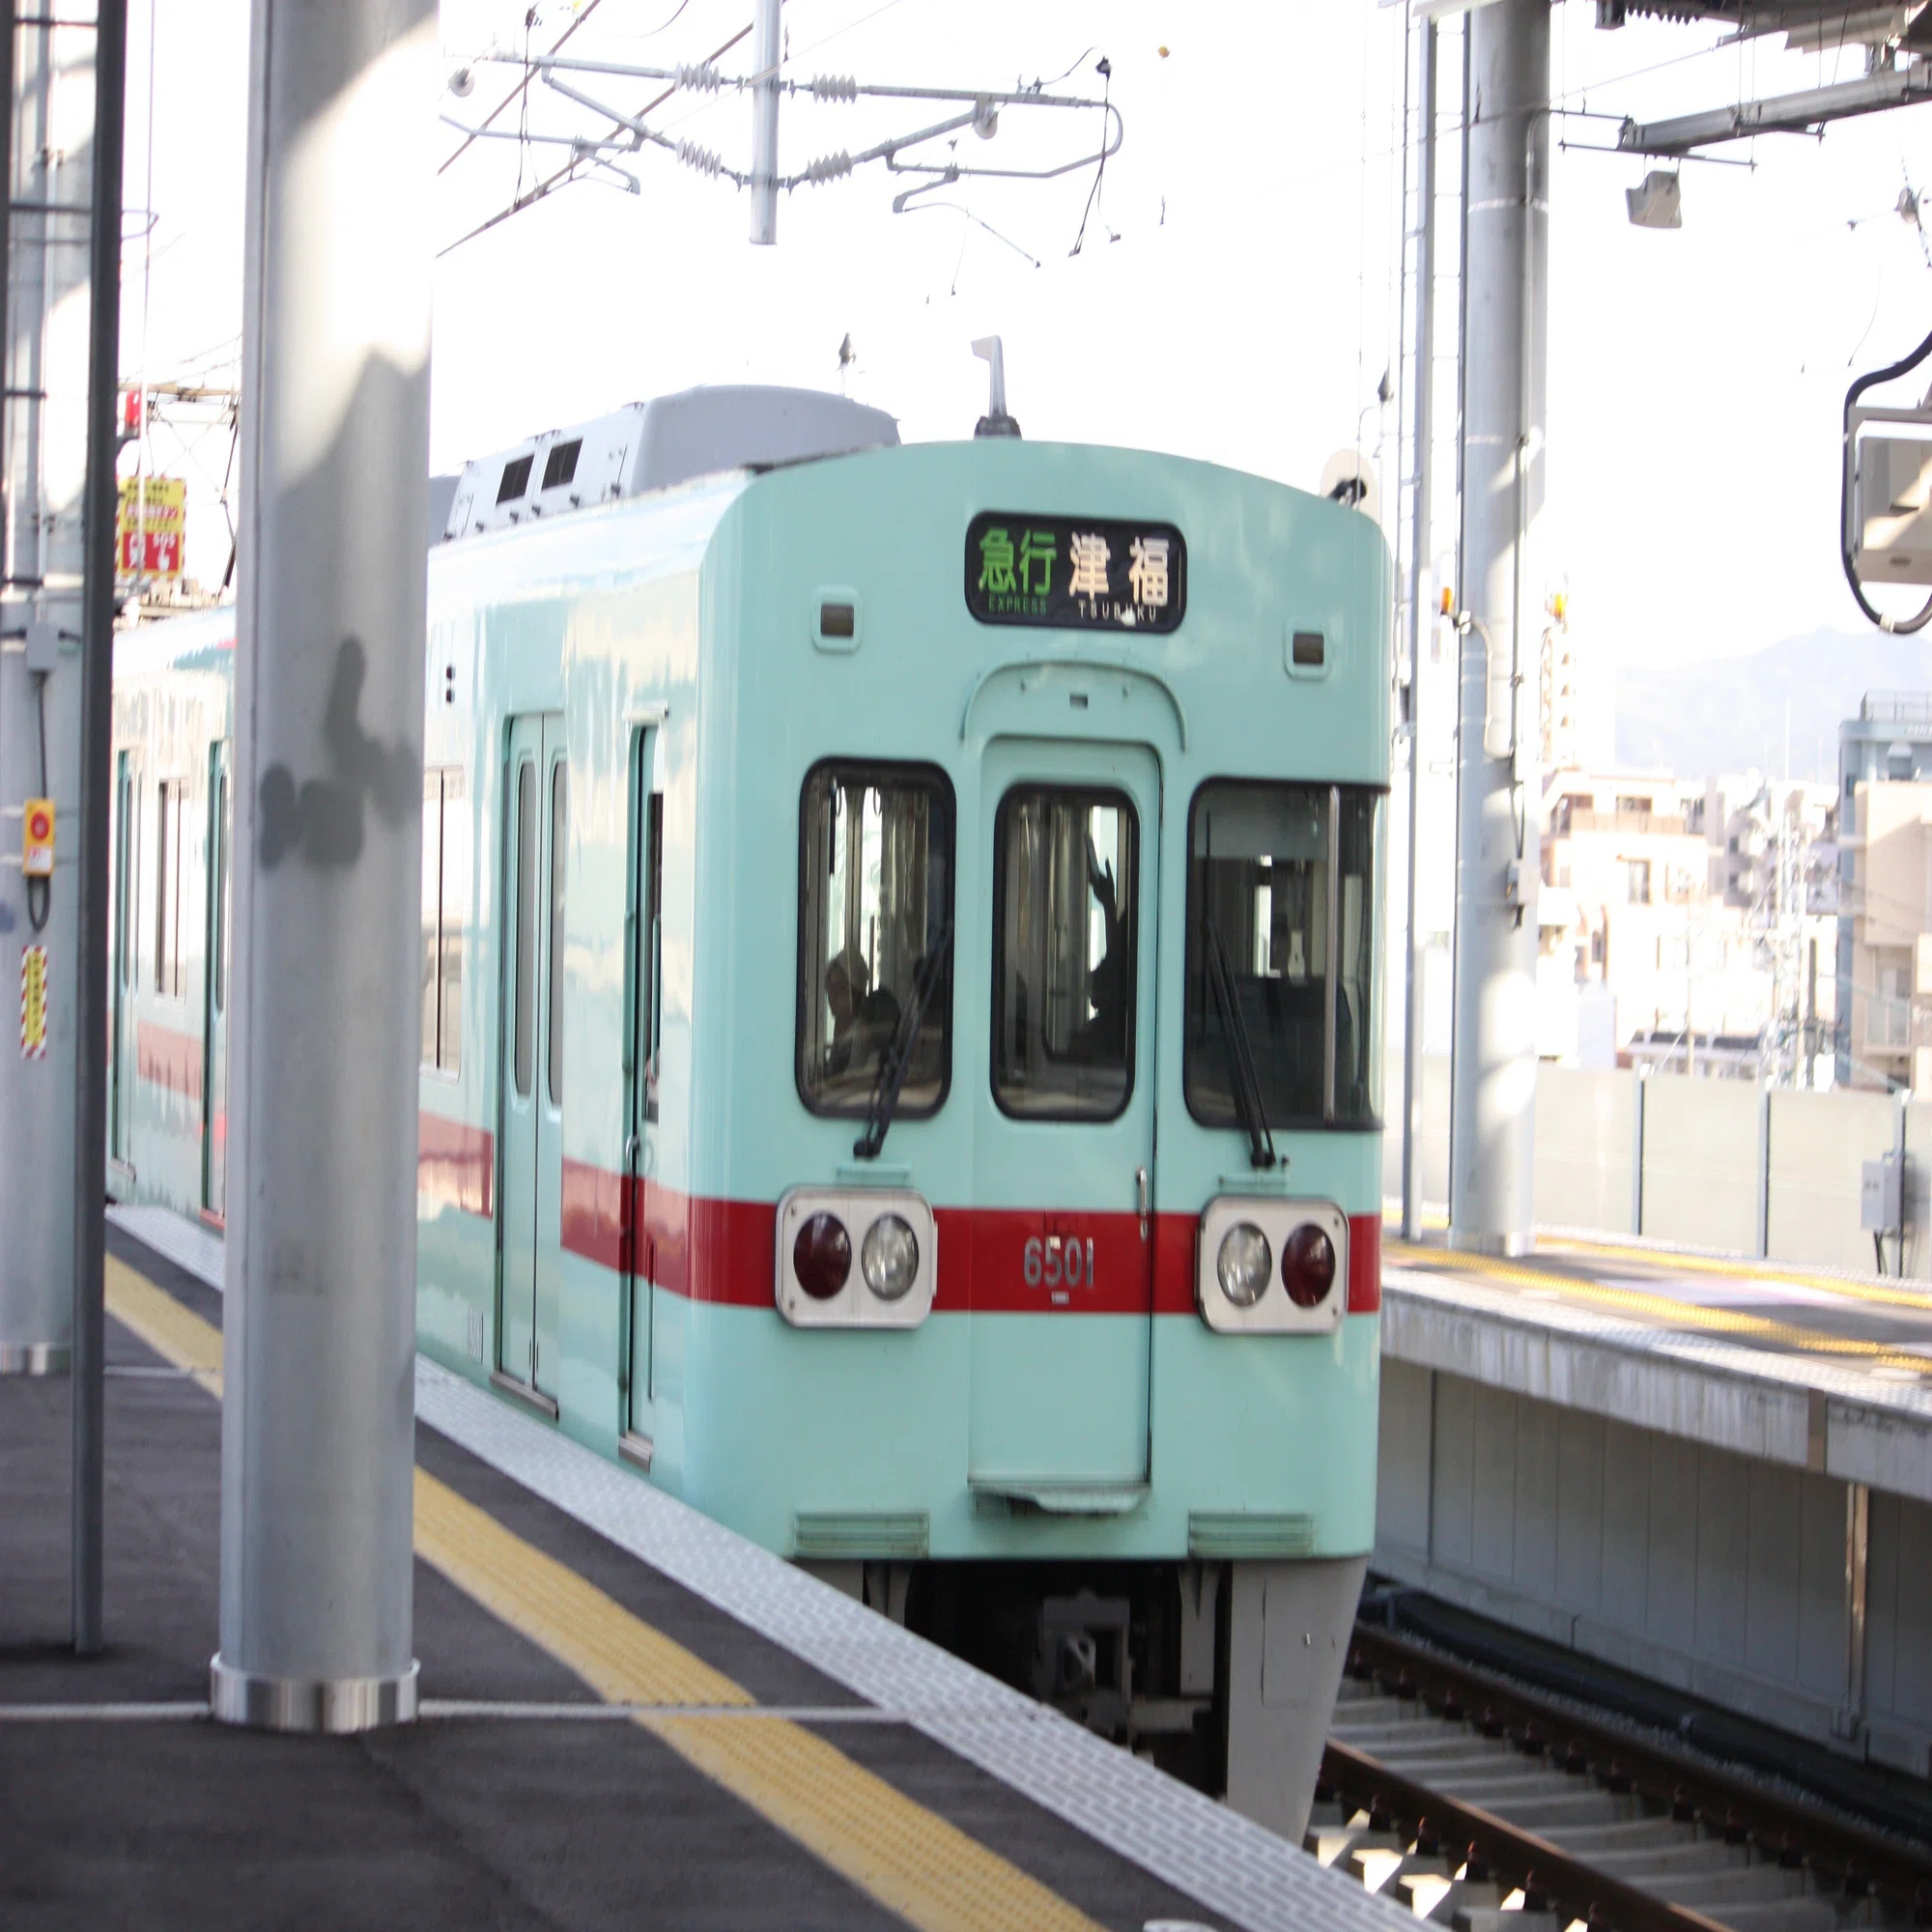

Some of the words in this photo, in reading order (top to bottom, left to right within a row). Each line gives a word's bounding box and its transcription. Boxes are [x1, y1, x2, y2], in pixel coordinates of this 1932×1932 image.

[979, 528, 1057, 595] 急行
[988, 593, 1047, 615] EXPRESS
[1024, 1236, 1094, 1287] 6501
